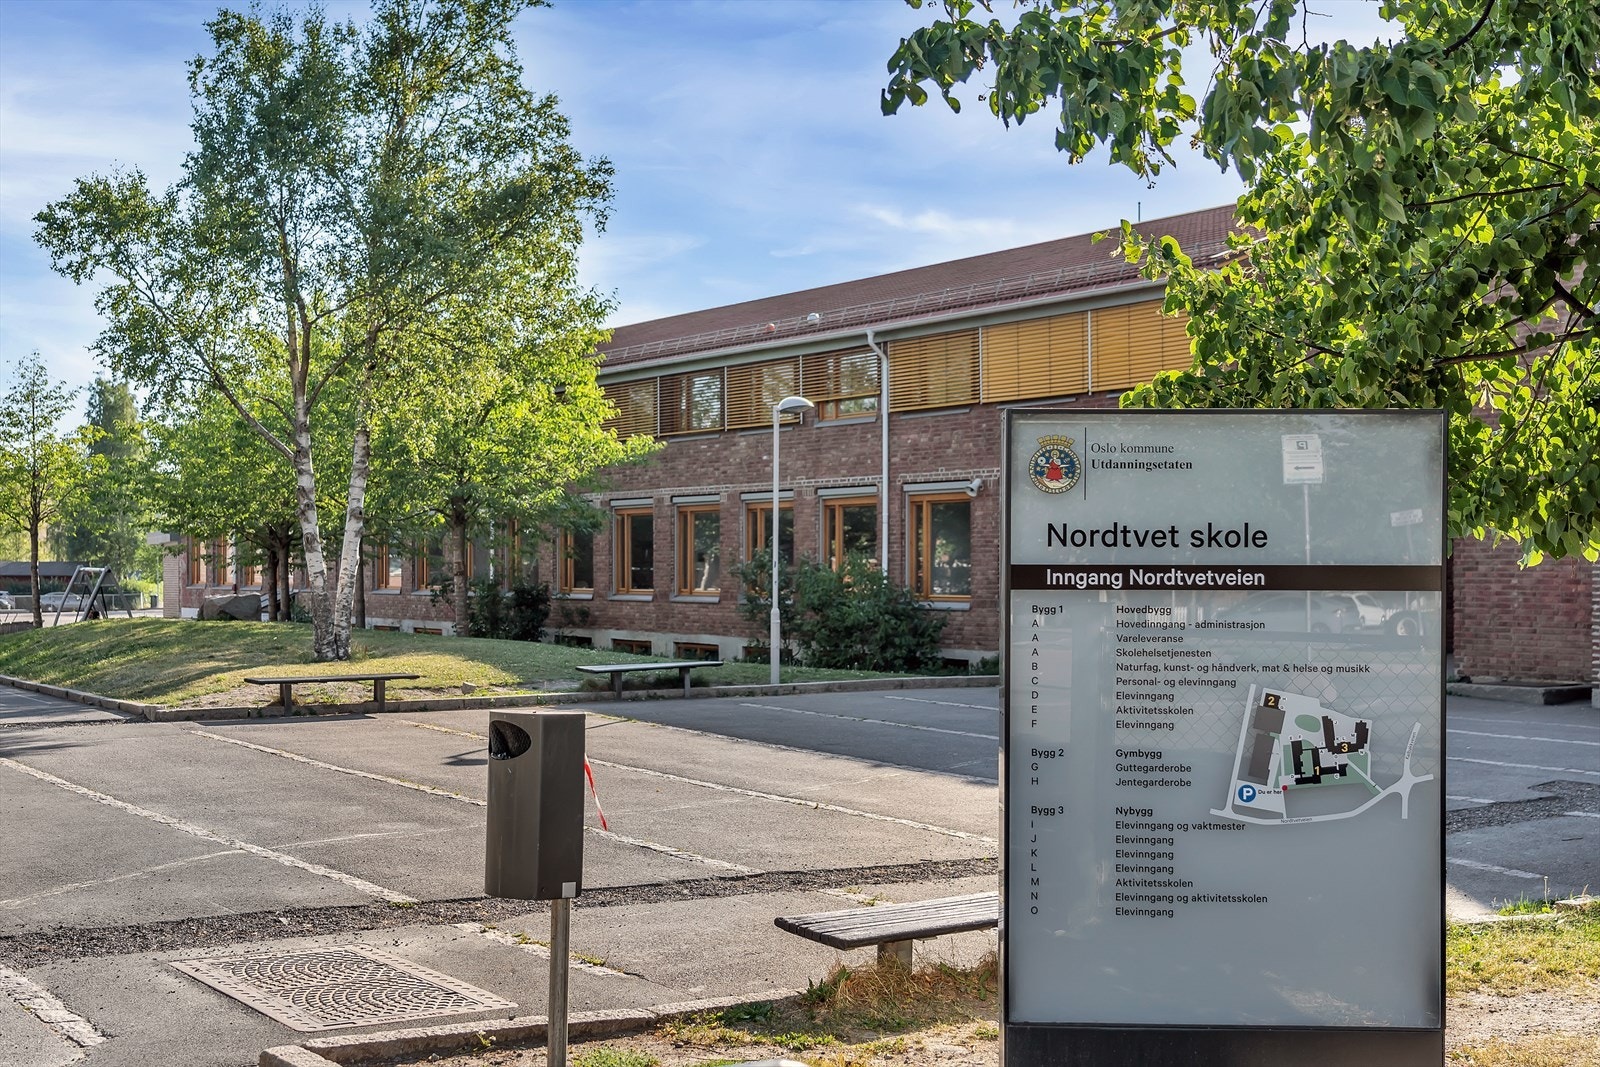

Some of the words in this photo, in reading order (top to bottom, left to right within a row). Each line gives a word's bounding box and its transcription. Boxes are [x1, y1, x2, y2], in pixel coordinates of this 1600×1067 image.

[1090, 442, 1117, 455] Oslo
[1120, 442, 1175, 455] kommune
[1090, 457, 1193, 473] Utdanningsetaten
[1047, 521, 1180, 549] Nordtvet
[1189, 521, 1268, 549] skole
[1046, 567, 1123, 590] Inngang
[1129, 567, 1265, 587] Nordtvetveien
[1031, 604, 1057, 616] Bygg
[1058, 604, 1063, 614] 1
[1115, 604, 1172, 616] Hovedbygg
[1031, 618, 1039, 628] A
[1115, 619, 1186, 631] Hovedinngang
[1194, 619, 1266, 632] administrasjon
[1031, 633, 1039, 643] A
[1115, 633, 1184, 644] Vareleveranse
[1031, 647, 1039, 657] A
[1115, 647, 1212, 660] Skolehelsetjenesten
[1031, 662, 1038, 672] B
[1115, 662, 1162, 674] Naturfag,
[1163, 661, 1195, 673] kunst-
[1197, 664, 1209, 674] og
[1211, 662, 1260, 675] håndverk,
[1261, 663, 1280, 673] mat
[1282, 663, 1291, 673] &
[1293, 662, 1319, 674] helse
[1320, 665, 1333, 675] og
[1335, 663, 1371, 674] musikk
[1031, 676, 1039, 686] C
[1115, 676, 1161, 687] Personal-
[1163, 678, 1176, 689] og
[1178, 676, 1237, 689] elevinngang
[1031, 690, 1039, 700] D
[1115, 691, 1175, 703] Elevinngang
[1267, 696, 1275, 705] 2
[1031, 705, 1038, 715] E
[1115, 705, 1194, 717] Aktivitetsskolen
[1031, 719, 1038, 729] F
[1115, 719, 1175, 731] Elevinngang
[1341, 743, 1349, 752] 3
[1030, 748, 1056, 760] Bygg
[1058, 748, 1065, 758] 2
[1115, 748, 1163, 760] Gymbygg
[1031, 762, 1039, 772] G
[1115, 763, 1192, 775] Guttegarderobe
[1031, 777, 1039, 787] H
[1115, 777, 1192, 789] Jentegarderobe
[1030, 805, 1056, 817] Bygg
[1058, 805, 1064, 815] 3
[1115, 806, 1154, 818] Nybygg
[1115, 820, 1175, 832] Elevinngang
[1176, 822, 1189, 832] og
[1191, 820, 1246, 831] vaktmester
[1031, 834, 1037, 844] J
[1115, 835, 1175, 847] Elevinngang
[1031, 848, 1038, 858] K
[1115, 849, 1175, 861] Elevinngang
[1031, 863, 1037, 873] L
[1115, 864, 1175, 876] Elevinngang
[1031, 877, 1040, 887] M
[1115, 877, 1194, 888] Aktivitetsskolen
[1031, 891, 1039, 901] N
[1115, 892, 1175, 904] Elevinngang
[1176, 894, 1189, 904] og
[1190, 892, 1268, 904] aktivitetsskolen
[1031, 905, 1039, 915] O
[1115, 906, 1175, 919] Elevinngang
